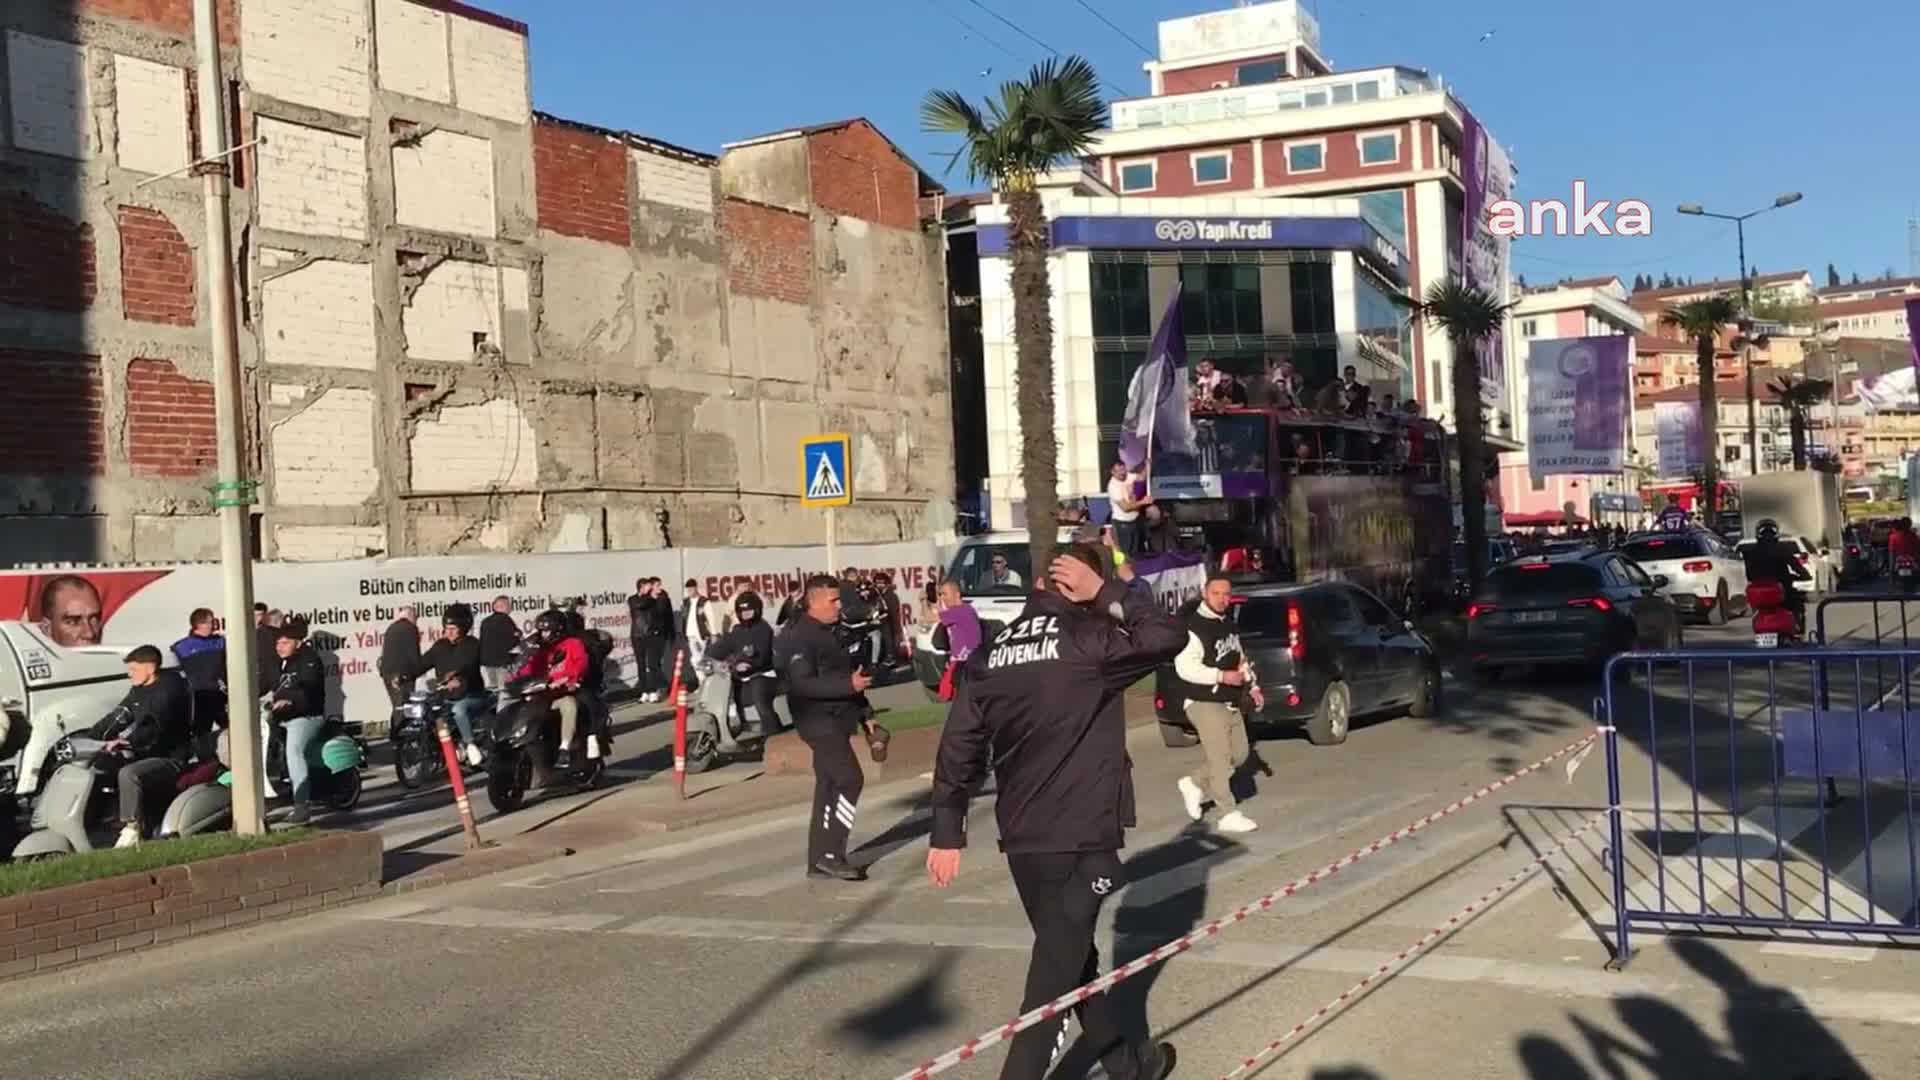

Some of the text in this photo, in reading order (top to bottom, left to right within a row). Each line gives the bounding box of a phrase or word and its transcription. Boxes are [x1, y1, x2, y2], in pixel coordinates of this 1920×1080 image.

[359, 572, 526, 596] Bütün cihan bilmelidir ki
[900, 566, 923, 590] VE
[353, 608, 371, 622] ve
[375, 604, 394, 621] bu
[399, 601, 449, 618] illeti
[511, 594, 545, 613] hiçbir
[304, 634, 351, 650] oktur.
[987, 635, 1060, 669] GÜVENLİK
